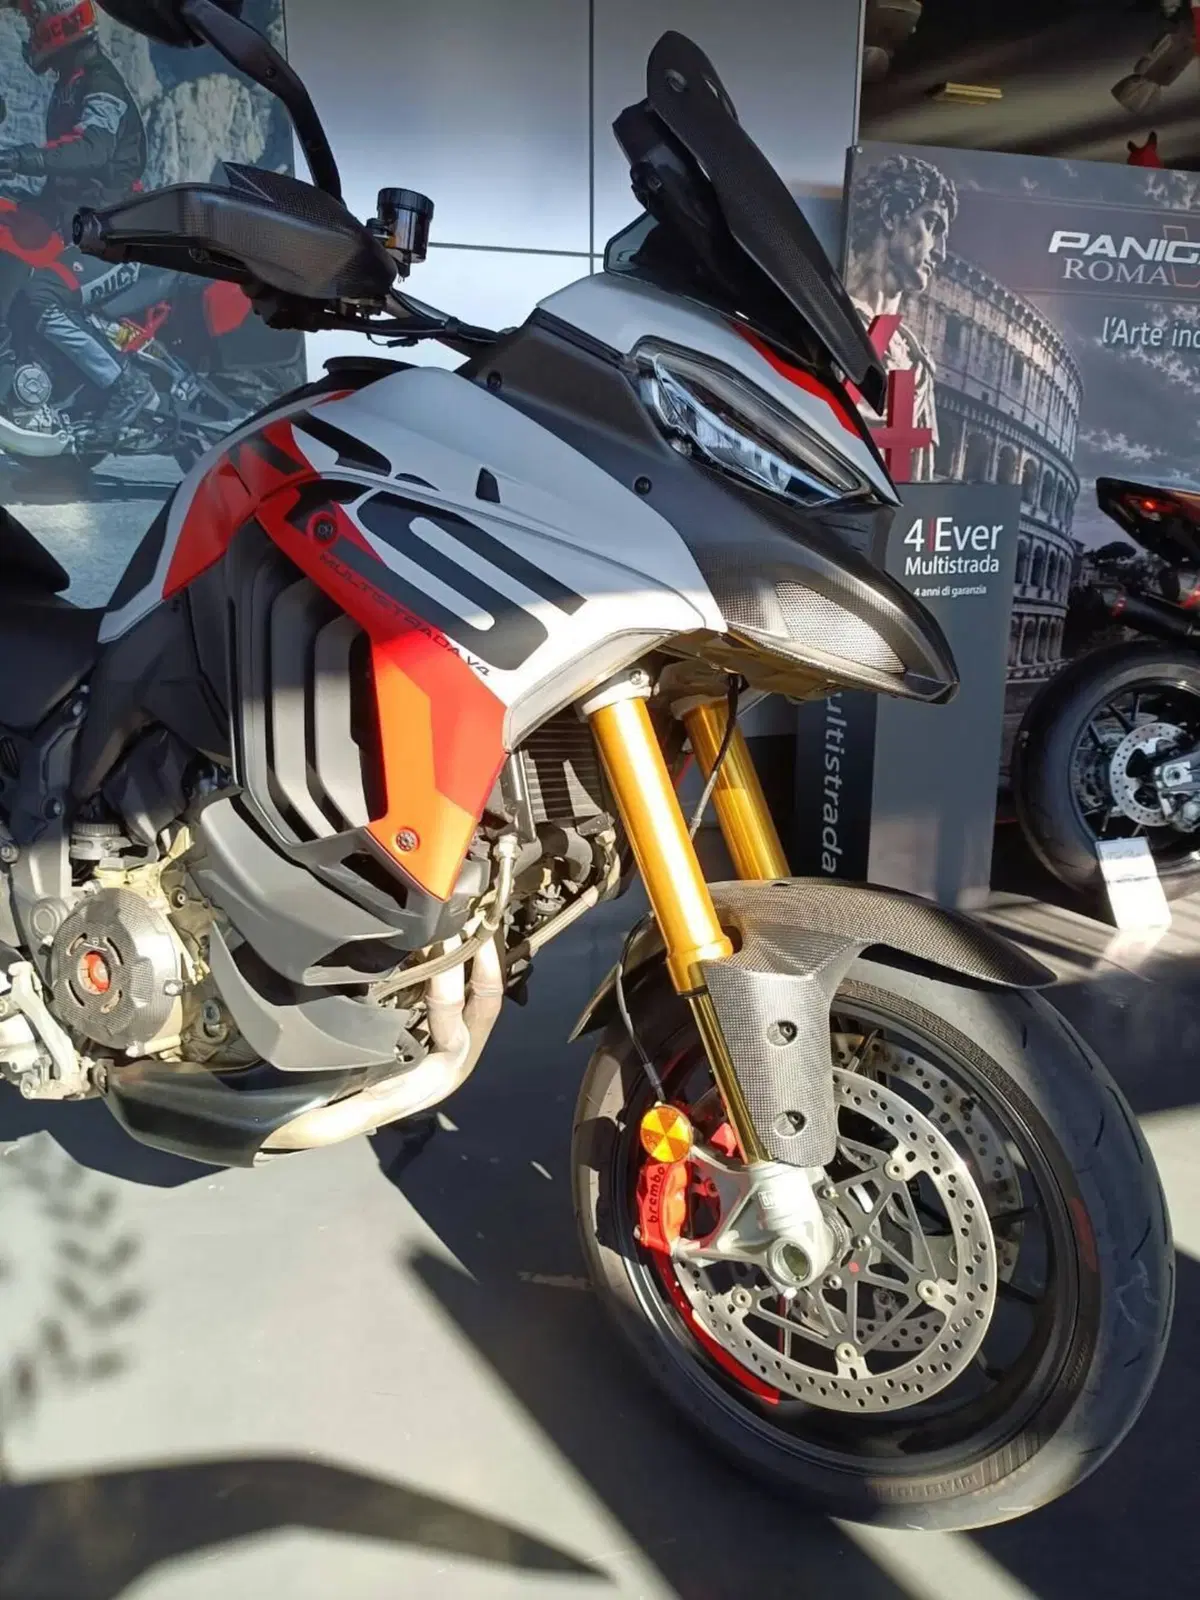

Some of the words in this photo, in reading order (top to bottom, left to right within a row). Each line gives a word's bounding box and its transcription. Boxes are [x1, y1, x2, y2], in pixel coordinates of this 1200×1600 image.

[1048, 230, 1200, 264] PANIG
[1061, 257, 1172, 286] ROMA
[1102, 316, 1163, 346] l'Arte
[904, 553, 1000, 576] Multistrada
[921, 586, 940, 598] anni
[941, 585, 951, 597] di
[951, 585, 987, 599] garanzia
[319, 552, 462, 659] MULTISTRADA
[466, 655, 490, 677] V4
[820, 691, 848, 874] ultistrada
[648, 1166, 666, 1224] brembo
